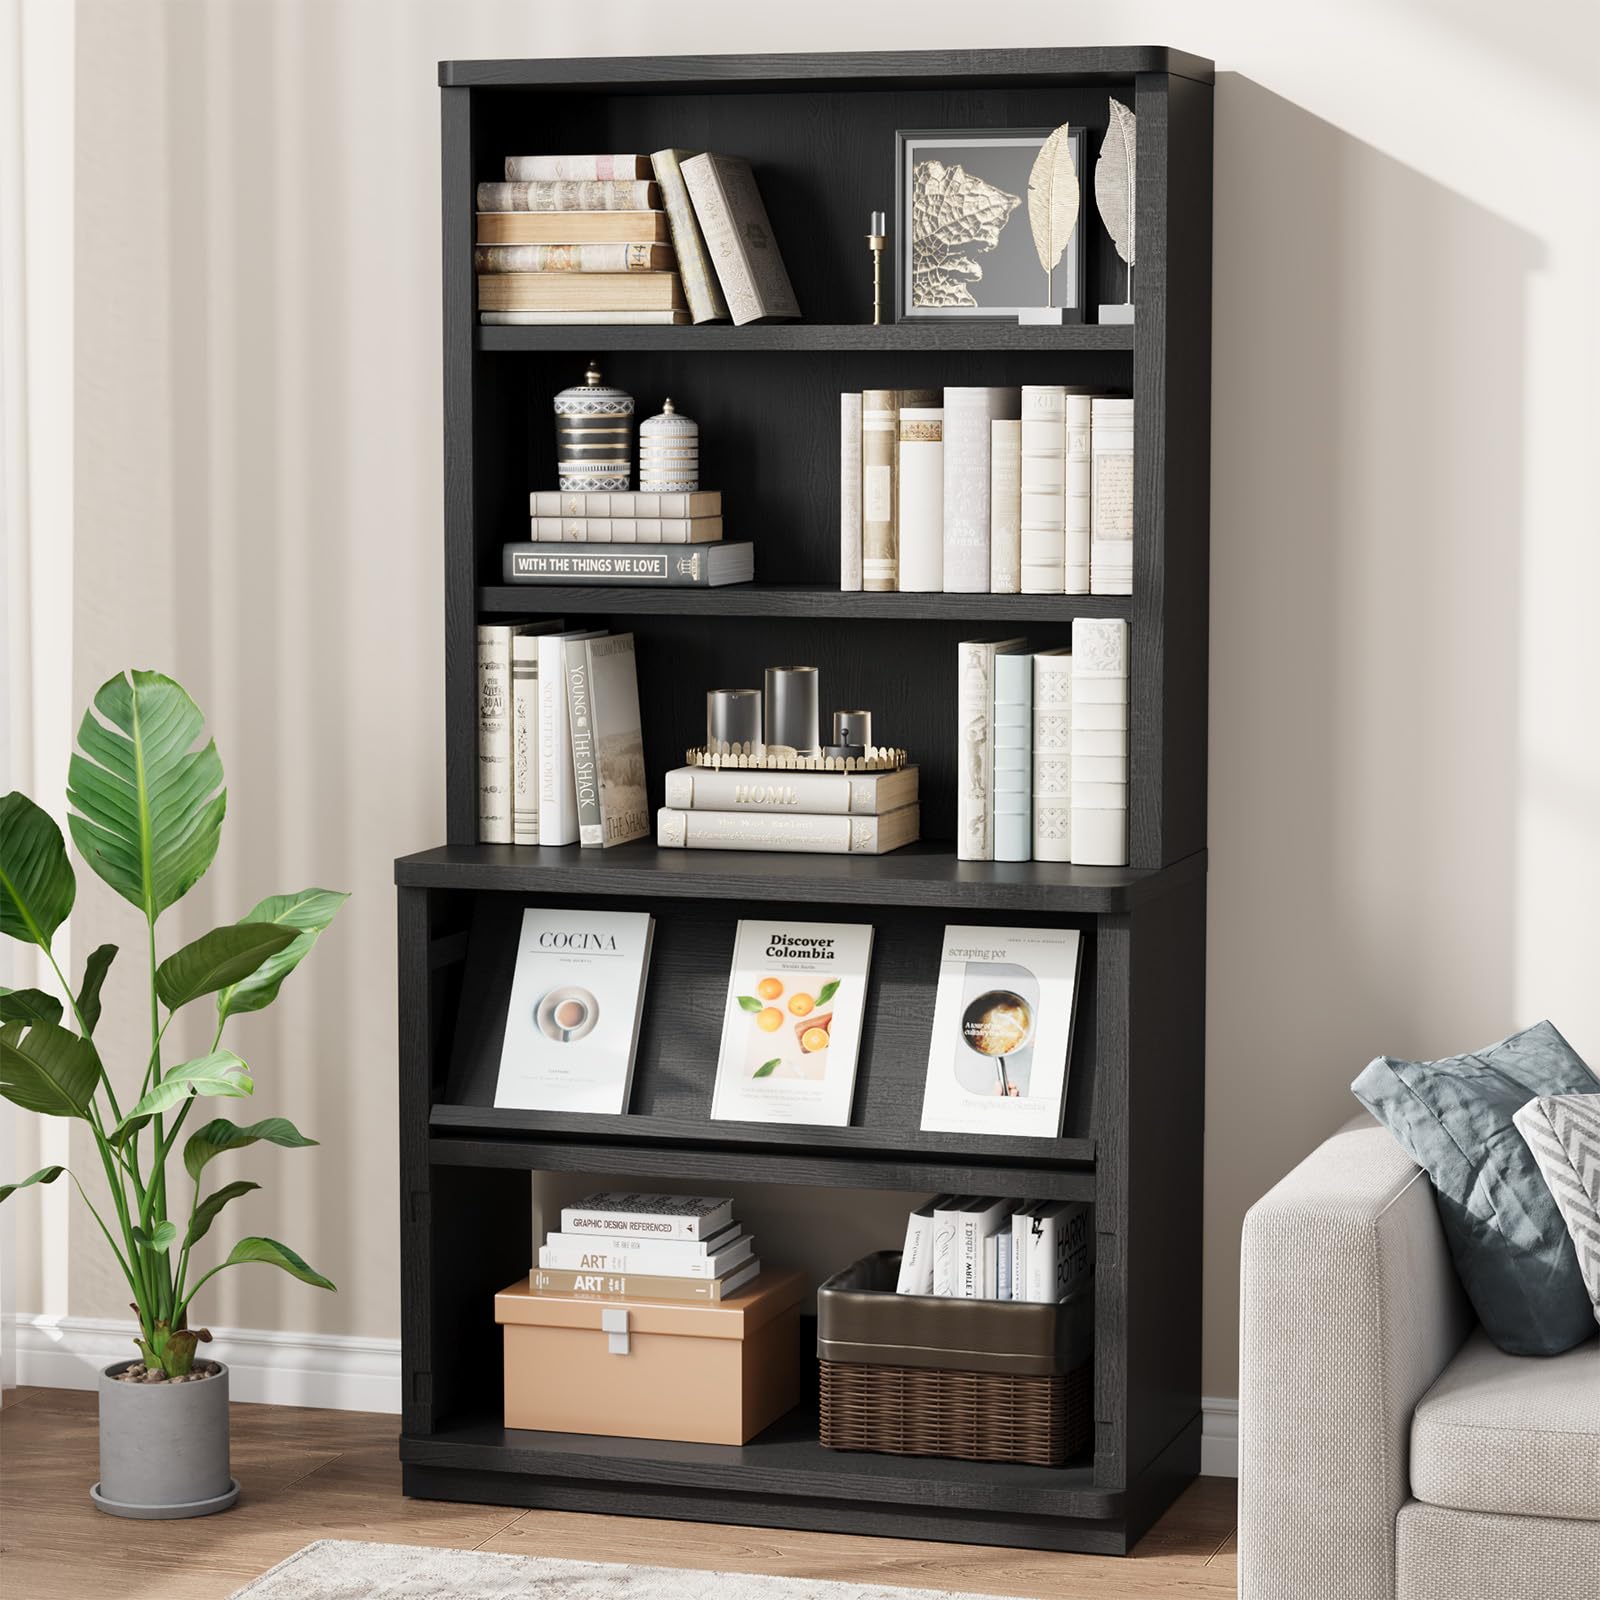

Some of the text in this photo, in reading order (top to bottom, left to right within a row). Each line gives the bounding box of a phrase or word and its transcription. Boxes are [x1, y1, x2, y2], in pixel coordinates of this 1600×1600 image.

[630, 245, 646, 267] 144
[518, 557, 660, 573] WITH THE THINGS WE LOVE
[571, 665, 596, 808] YOUNG THE SHACK
[734, 784, 798, 805] HOME
[539, 931, 617, 950] COCINA
[770, 934, 835, 947] Discover
[765, 946, 835, 959] Colombia
[948, 948, 1007, 960] scraping pot
[573, 1218, 673, 1233] GRAPHIC DESIGN REFERENCED
[1057, 1207, 1088, 1260] HARRY
[580, 1254, 607, 1269] ART
[1057, 1244, 1088, 1288] POTTER
[573, 1275, 605, 1292] ART
